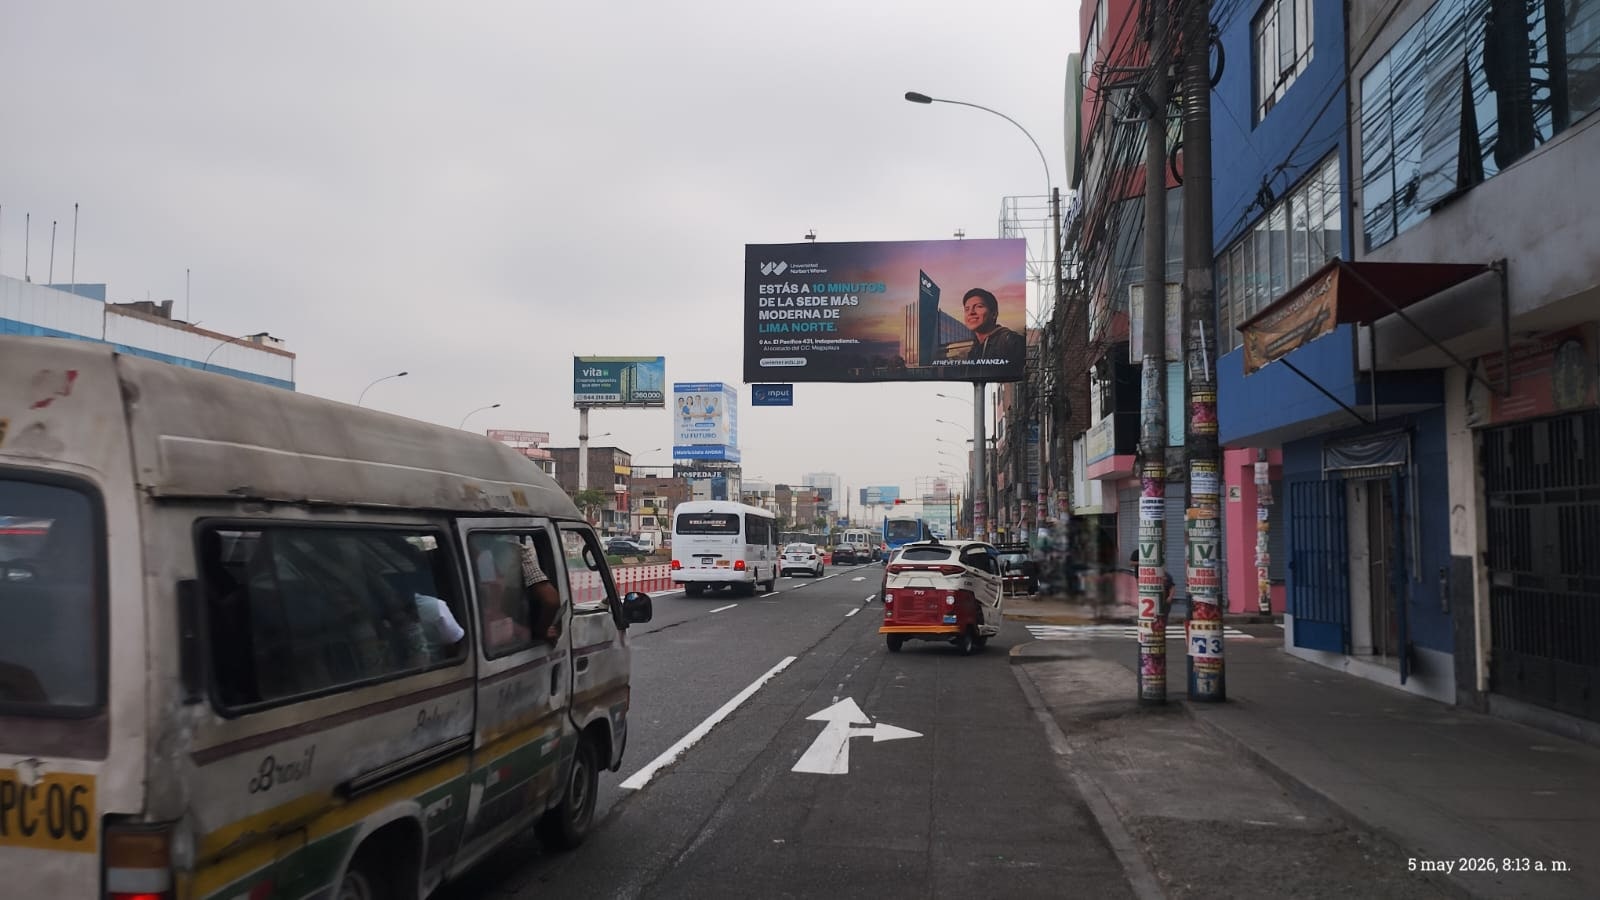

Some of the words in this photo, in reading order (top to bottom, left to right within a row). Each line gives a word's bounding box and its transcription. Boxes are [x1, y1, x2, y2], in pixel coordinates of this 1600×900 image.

[759, 281, 799, 294] ESTÁS
[801, 283, 810, 293] A
[812, 283, 825, 293] 10
[827, 282, 886, 293] MINUTOS
[759, 297, 775, 307] DE
[778, 297, 794, 307] LA
[796, 296, 828, 306] SEDE
[830, 293, 859, 306] MÁS
[759, 308, 821, 320] MODERNA
[823, 308, 840, 319] DE
[759, 322, 789, 333] LIMA
[791, 321, 838, 332] NORTE.
[582, 367, 602, 377] vita
[1140, 543, 1154, 558] V
[1197, 545, 1214, 559] V
[1141, 598, 1155, 617] 2
[249, 743, 316, 794] Brasil
